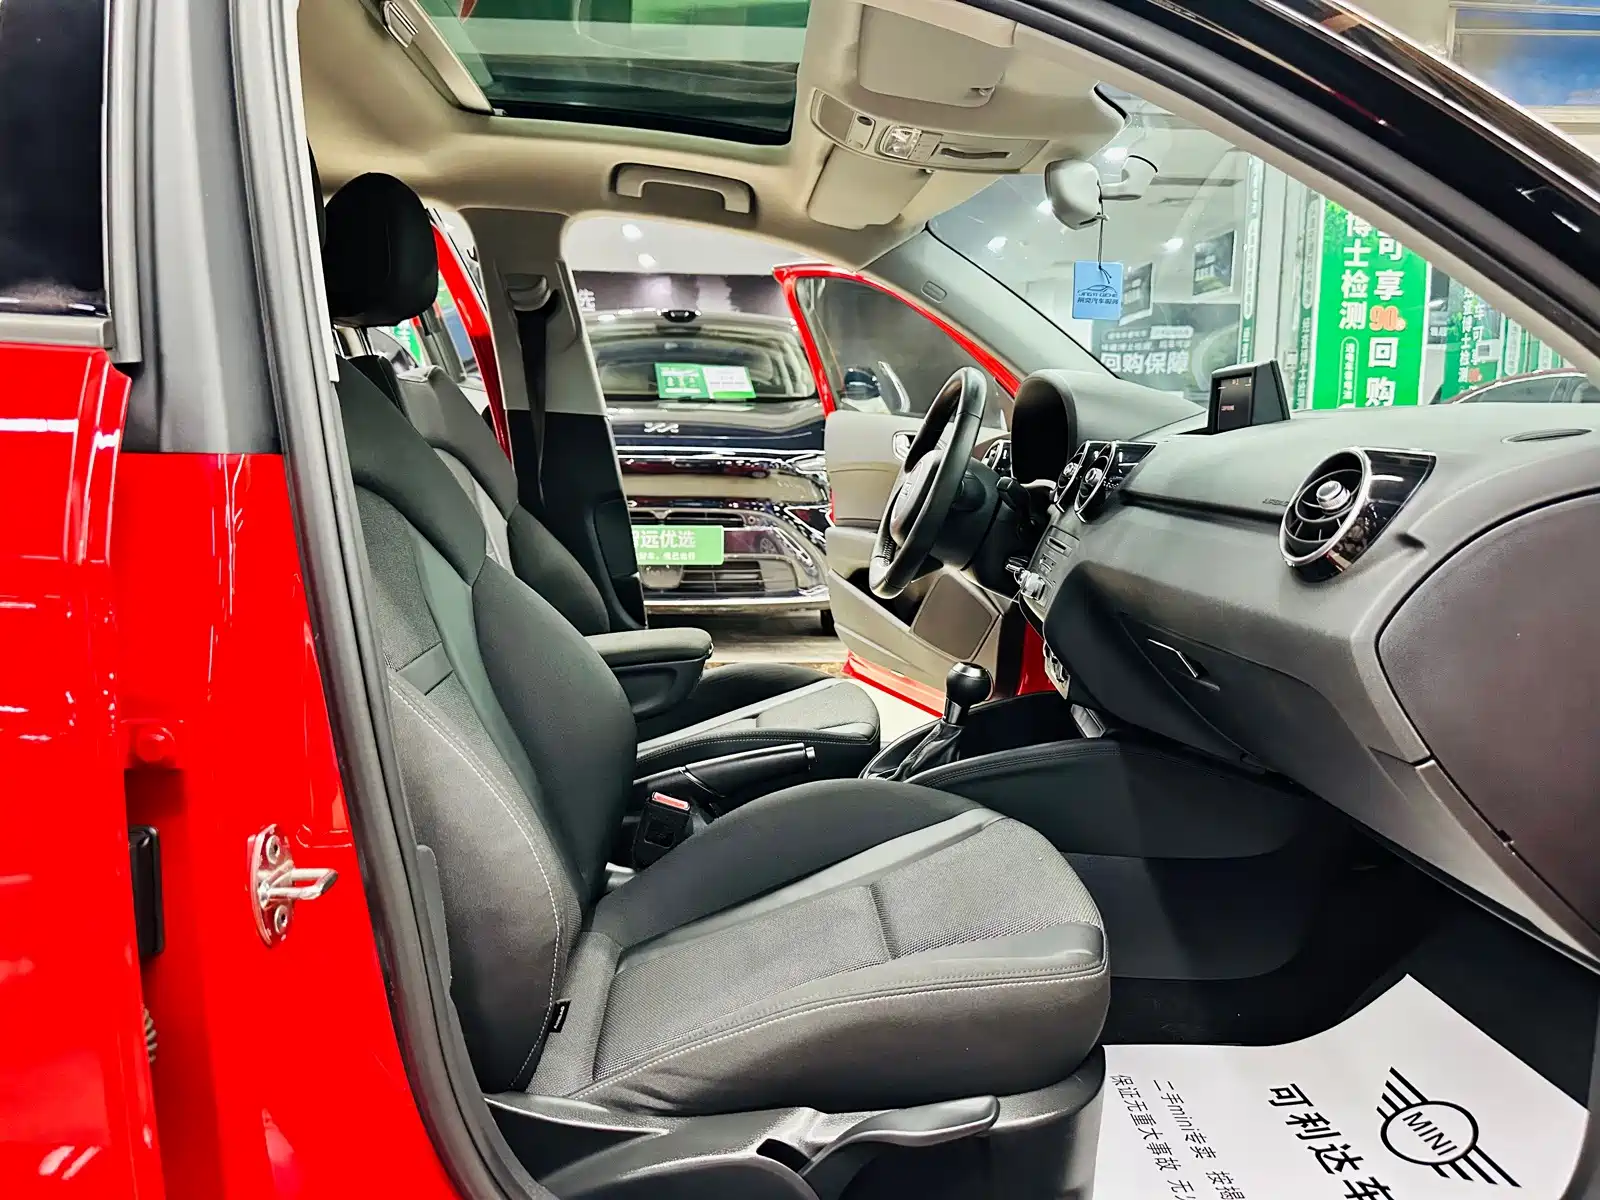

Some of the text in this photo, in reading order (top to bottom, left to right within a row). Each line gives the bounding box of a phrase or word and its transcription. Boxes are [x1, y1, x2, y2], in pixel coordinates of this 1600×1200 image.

[1109, 1074, 1182, 1171] 保证无重大事故
[1153, 1079, 1217, 1159] 二手mini专卖
[1402, 1111, 1458, 1156] MINI
